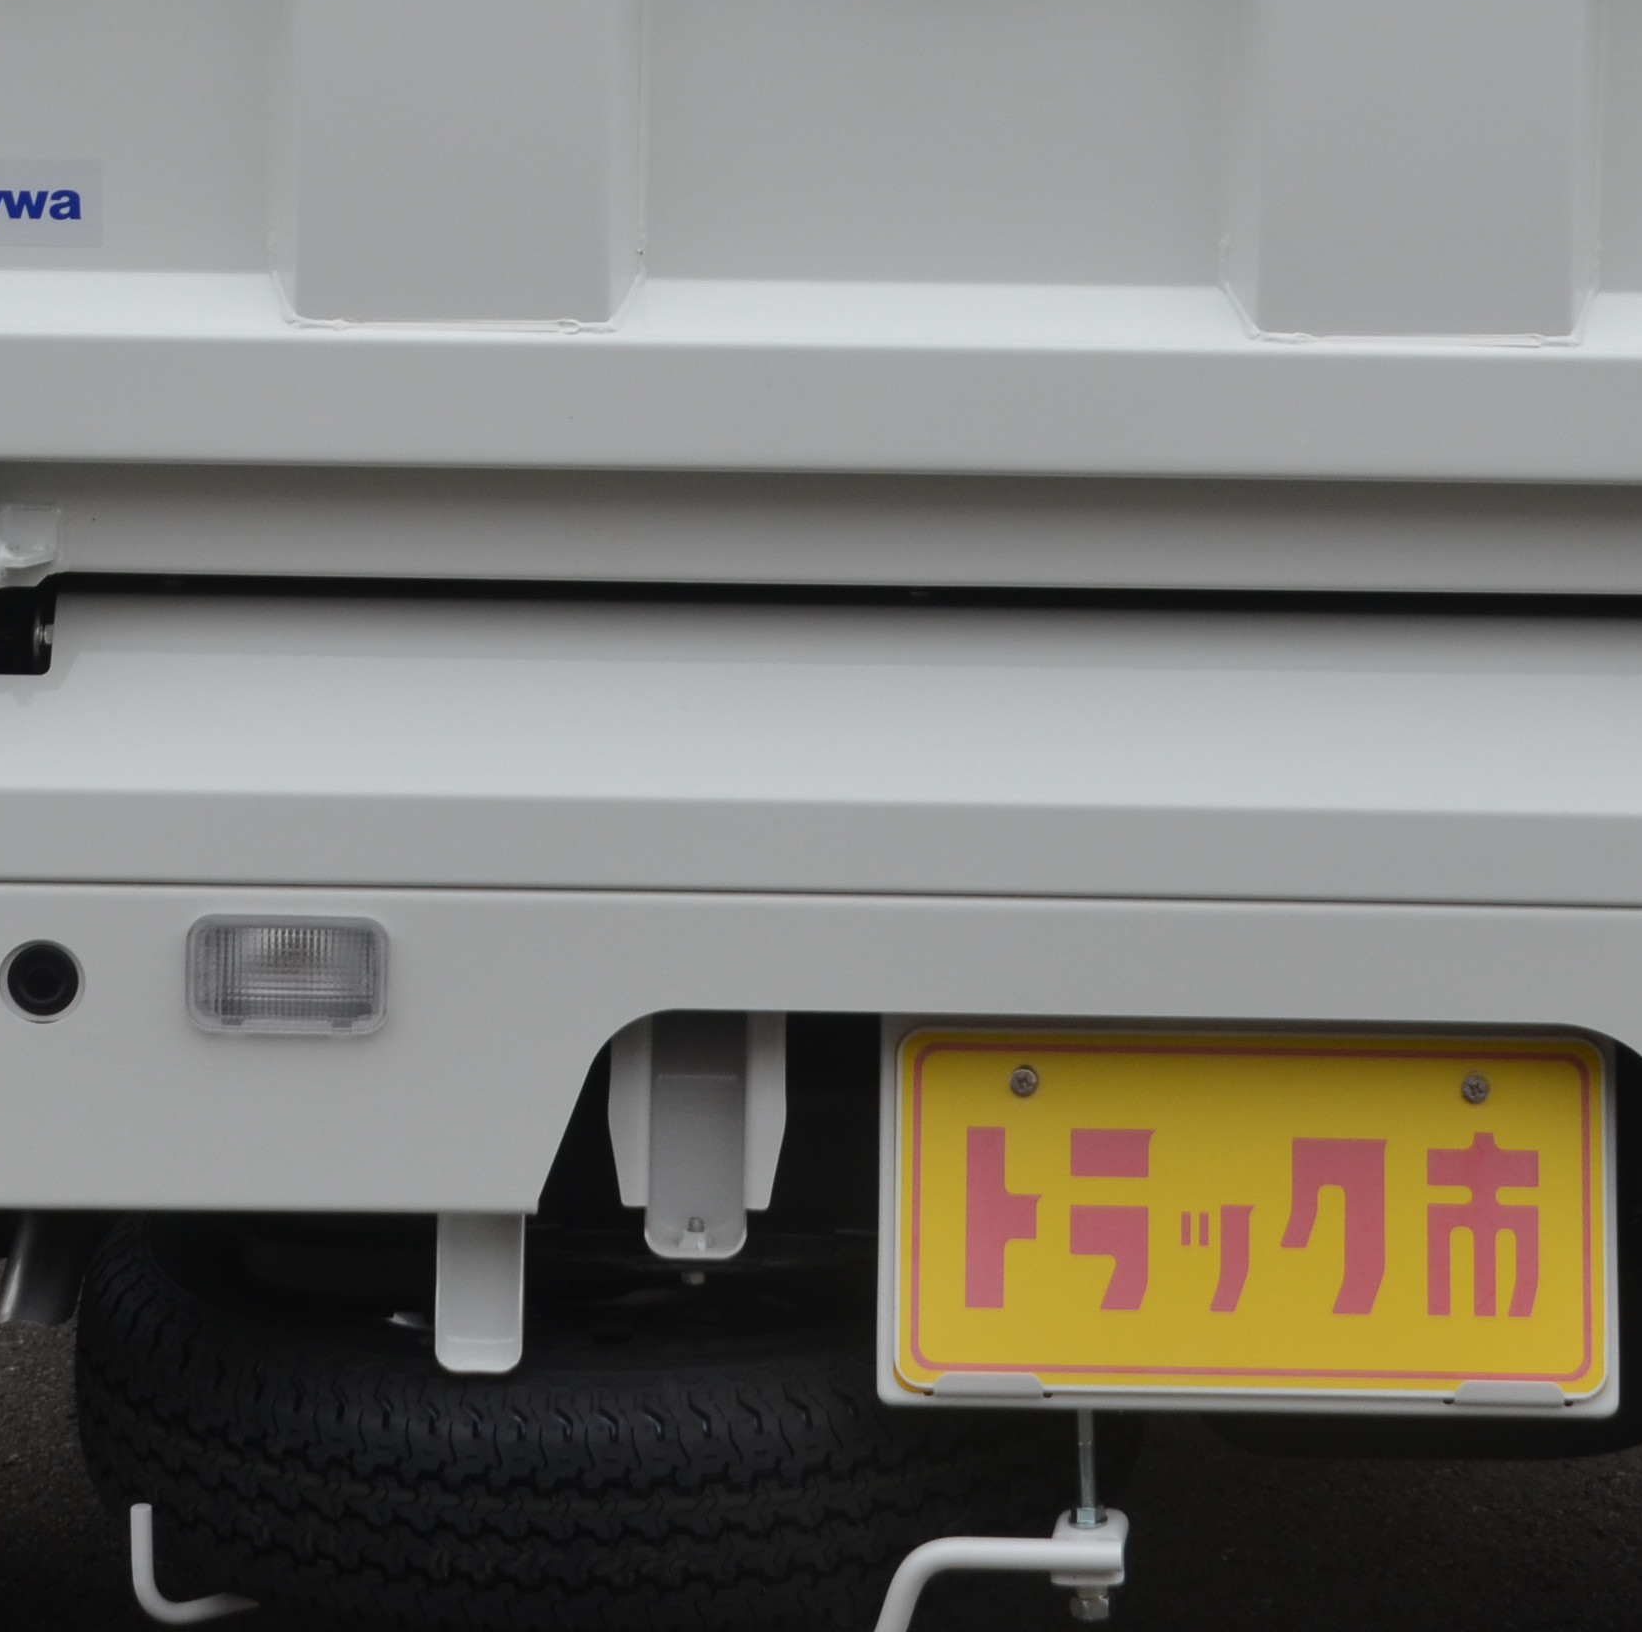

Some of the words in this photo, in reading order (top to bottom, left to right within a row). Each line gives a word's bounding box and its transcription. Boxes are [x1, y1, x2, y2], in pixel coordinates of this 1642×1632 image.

[964, 1125, 1540, 1319] トラック市
